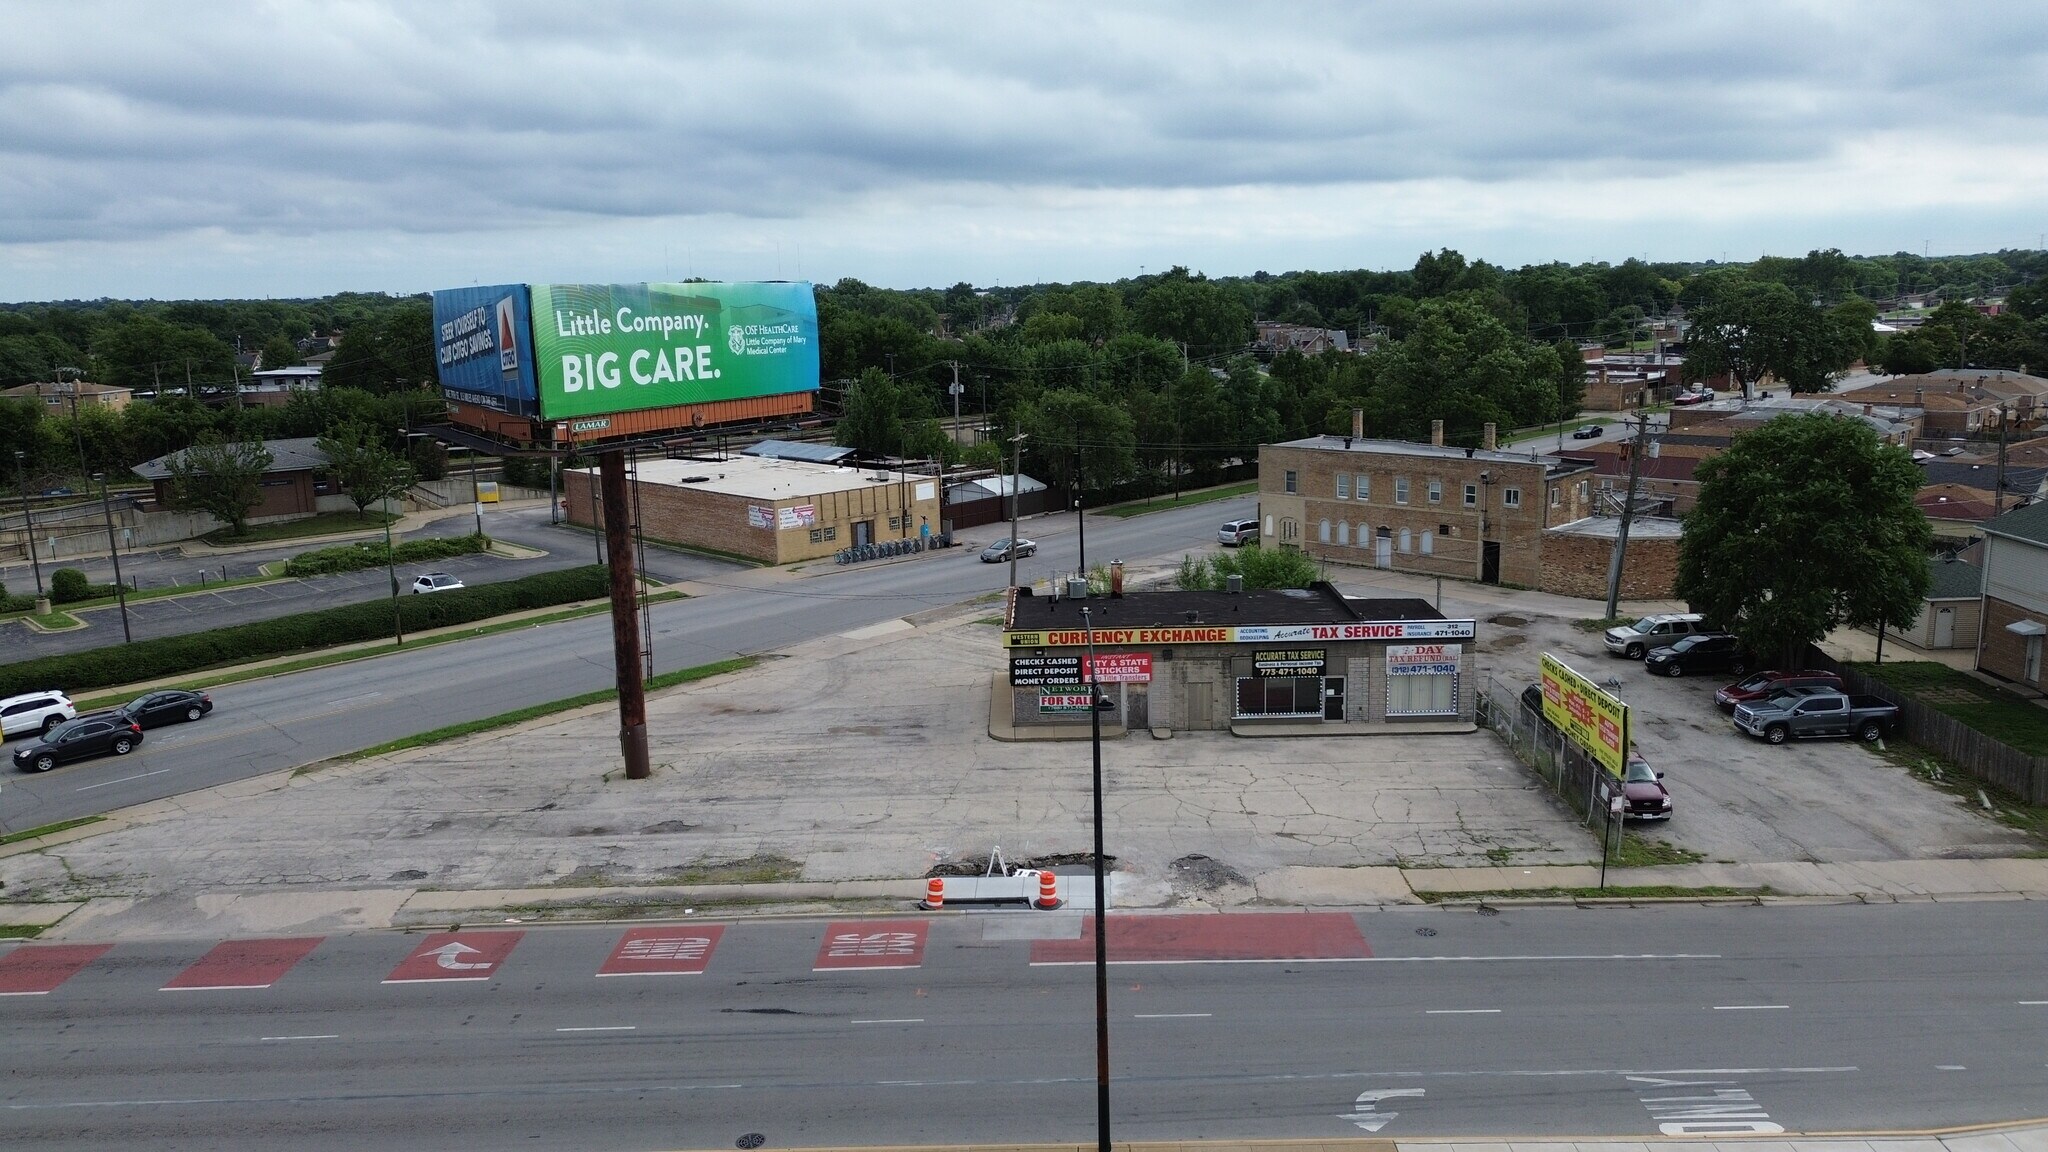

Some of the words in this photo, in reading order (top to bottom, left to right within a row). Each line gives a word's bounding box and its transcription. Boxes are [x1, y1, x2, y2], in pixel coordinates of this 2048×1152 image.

[442, 321, 454, 342] STEER
[454, 309, 478, 337] YOURSELF
[478, 306, 486, 326] TO
[556, 308, 611, 336] Little
[616, 307, 709, 340] Company.
[744, 325, 758, 335] OSF
[452, 338, 468, 360] CITGO
[469, 329, 494, 355] SAVINGS.
[746, 338, 760, 346] Little
[760, 337, 786, 346] Company
[793, 336, 806, 345] Mary
[747, 347, 768, 355] Medical
[503, 350, 515, 366] CITGO
[562, 352, 621, 392] BIG
[630, 345, 721, 385] CARE.
[575, 420, 608, 430] LAMAR
[1048, 631, 1134, 645] CURRENCY
[1140, 629, 1226, 642] EXCHANGE
[1273, 628, 1310, 640] Accurate
[1312, 627, 1339, 639] TAX
[1344, 625, 1402, 638] SERVICE
[1256, 652, 1286, 660] ACCURATE
[1287, 651, 1299, 660] TAX
[1300, 651, 1324, 659] SERVICE
[1015, 658, 1044, 666] CHECKS
[1095, 666, 1140, 674] STICKERS
[1260, 667, 1318, 676] 773-471-1040
[1411, 665, 1455, 673] 471-1040
[1542, 658, 1557, 676] CHECKS
[1559, 670, 1576, 688] CASHED
[1580, 684, 1596, 702] DIRECT
[1598, 695, 1620, 719] DEPOSIT
[1042, 697, 1063, 705] FOR
[1580, 739, 1596, 756] ORDERS
